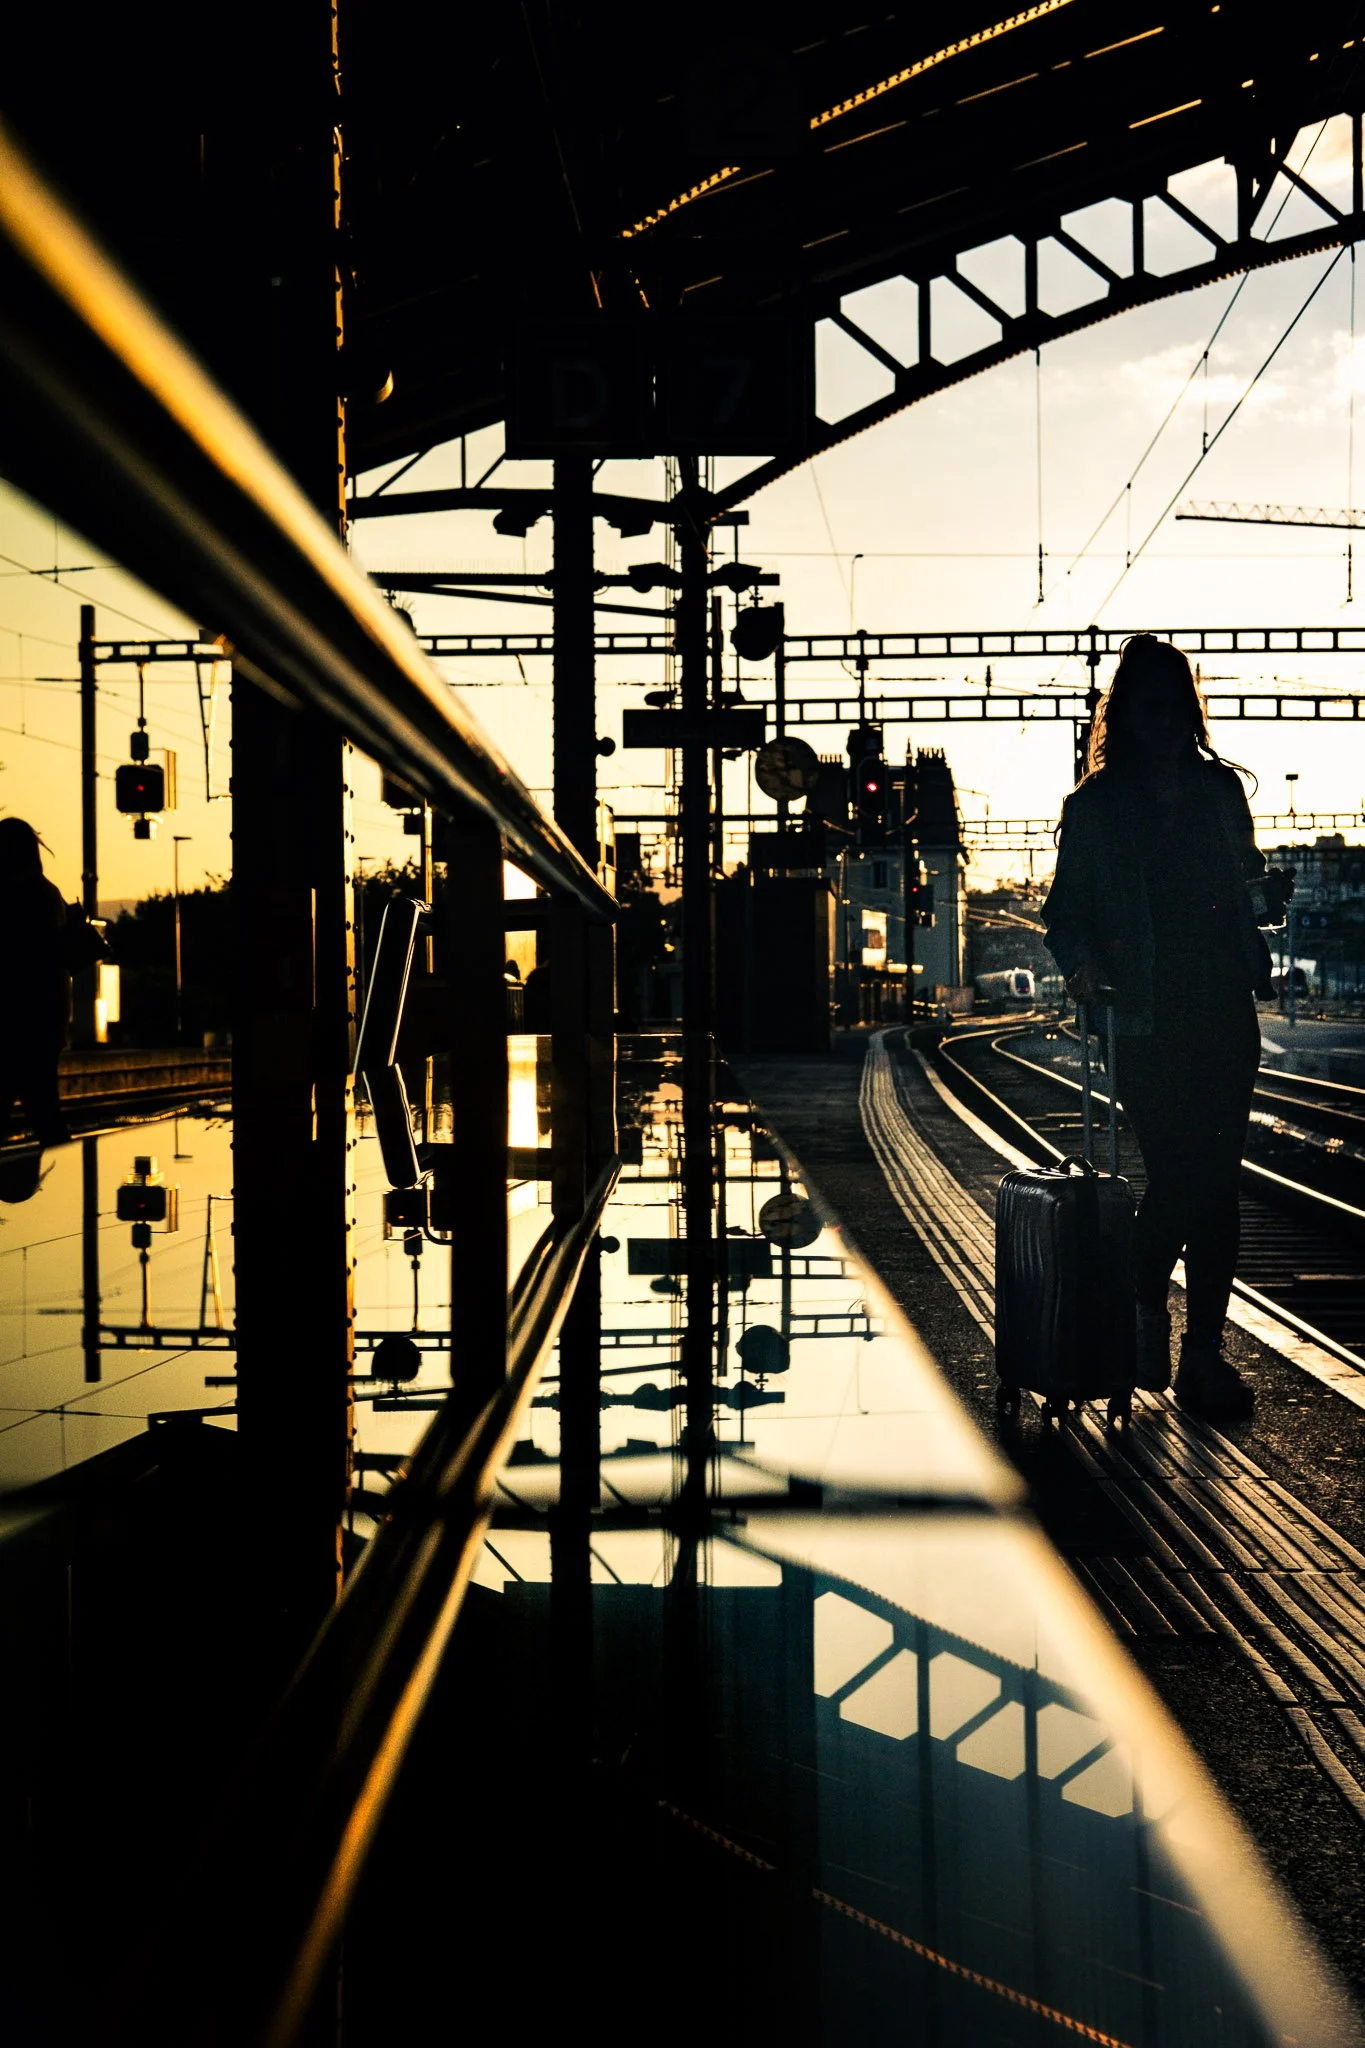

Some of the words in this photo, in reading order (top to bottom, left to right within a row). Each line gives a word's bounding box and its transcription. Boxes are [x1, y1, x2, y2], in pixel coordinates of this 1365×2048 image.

[716, 62, 776, 141] 2
[552, 360, 609, 428] D
[703, 357, 753, 424] 7
